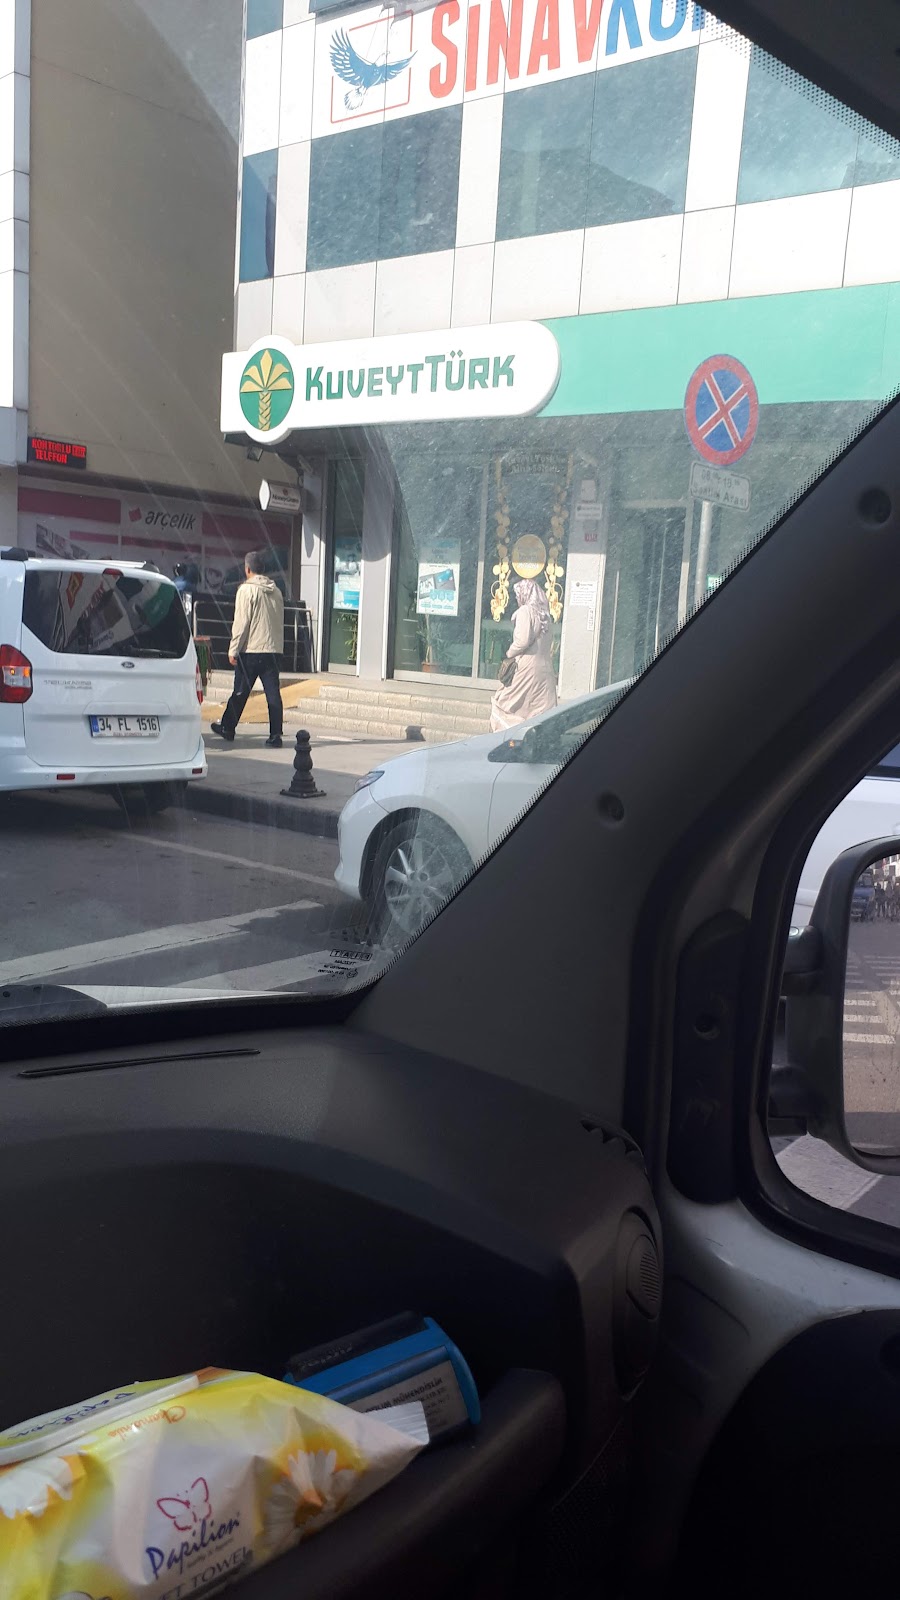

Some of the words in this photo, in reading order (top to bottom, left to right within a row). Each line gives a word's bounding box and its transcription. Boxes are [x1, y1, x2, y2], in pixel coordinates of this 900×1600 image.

[36, 449, 67, 464] TELEFON
[145, 511, 196, 530] arçelik
[99, 717, 111, 731] 34
[118, 717, 131, 731] FL
[136, 717, 157, 731] 1516
